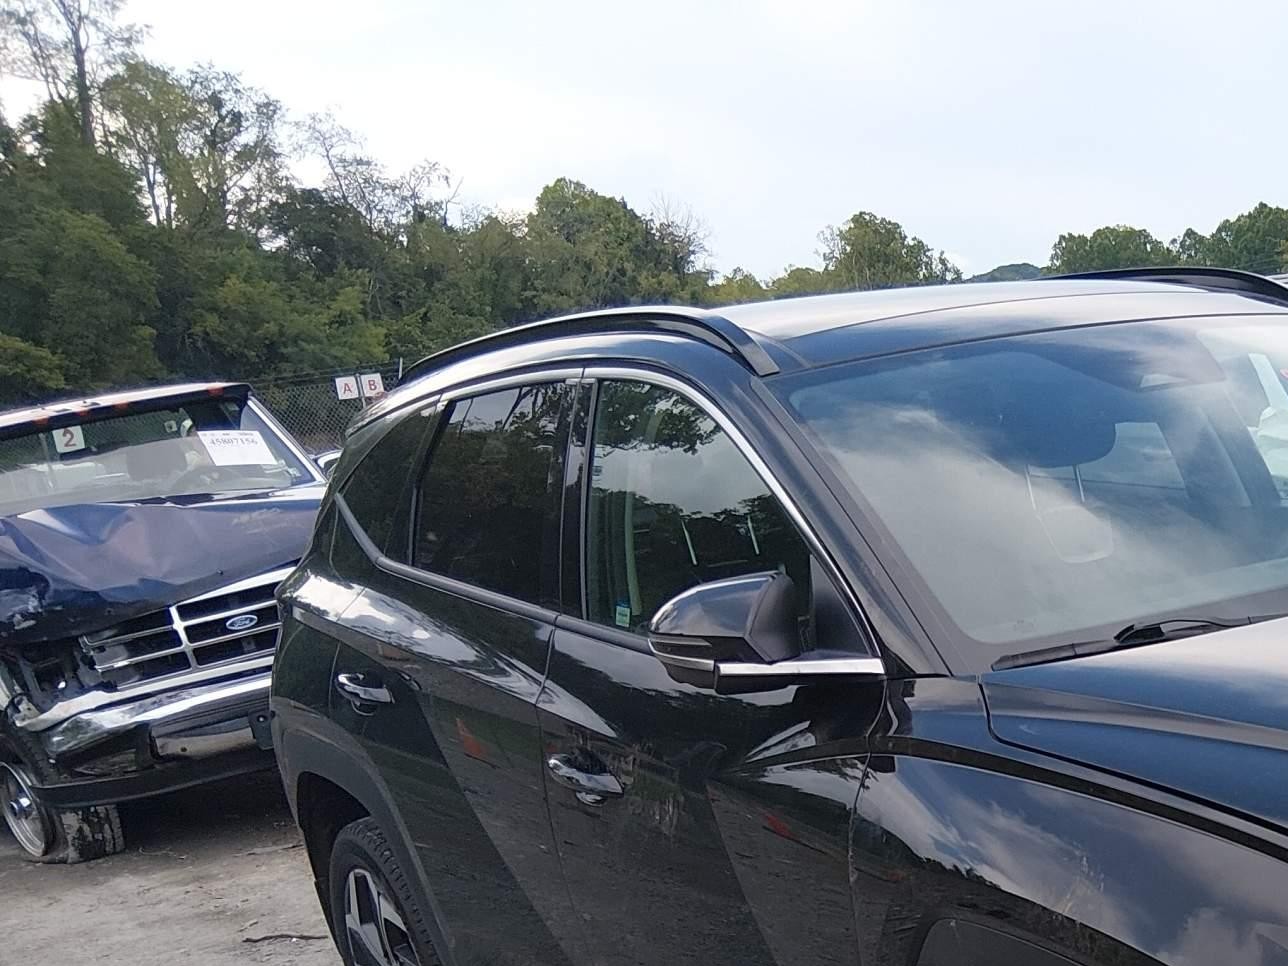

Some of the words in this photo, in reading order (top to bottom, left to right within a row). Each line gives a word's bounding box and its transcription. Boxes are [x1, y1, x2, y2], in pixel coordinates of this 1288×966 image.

[343, 383, 353, 394] A
[368, 379, 377, 391] B
[62, 427, 77, 447] 2
